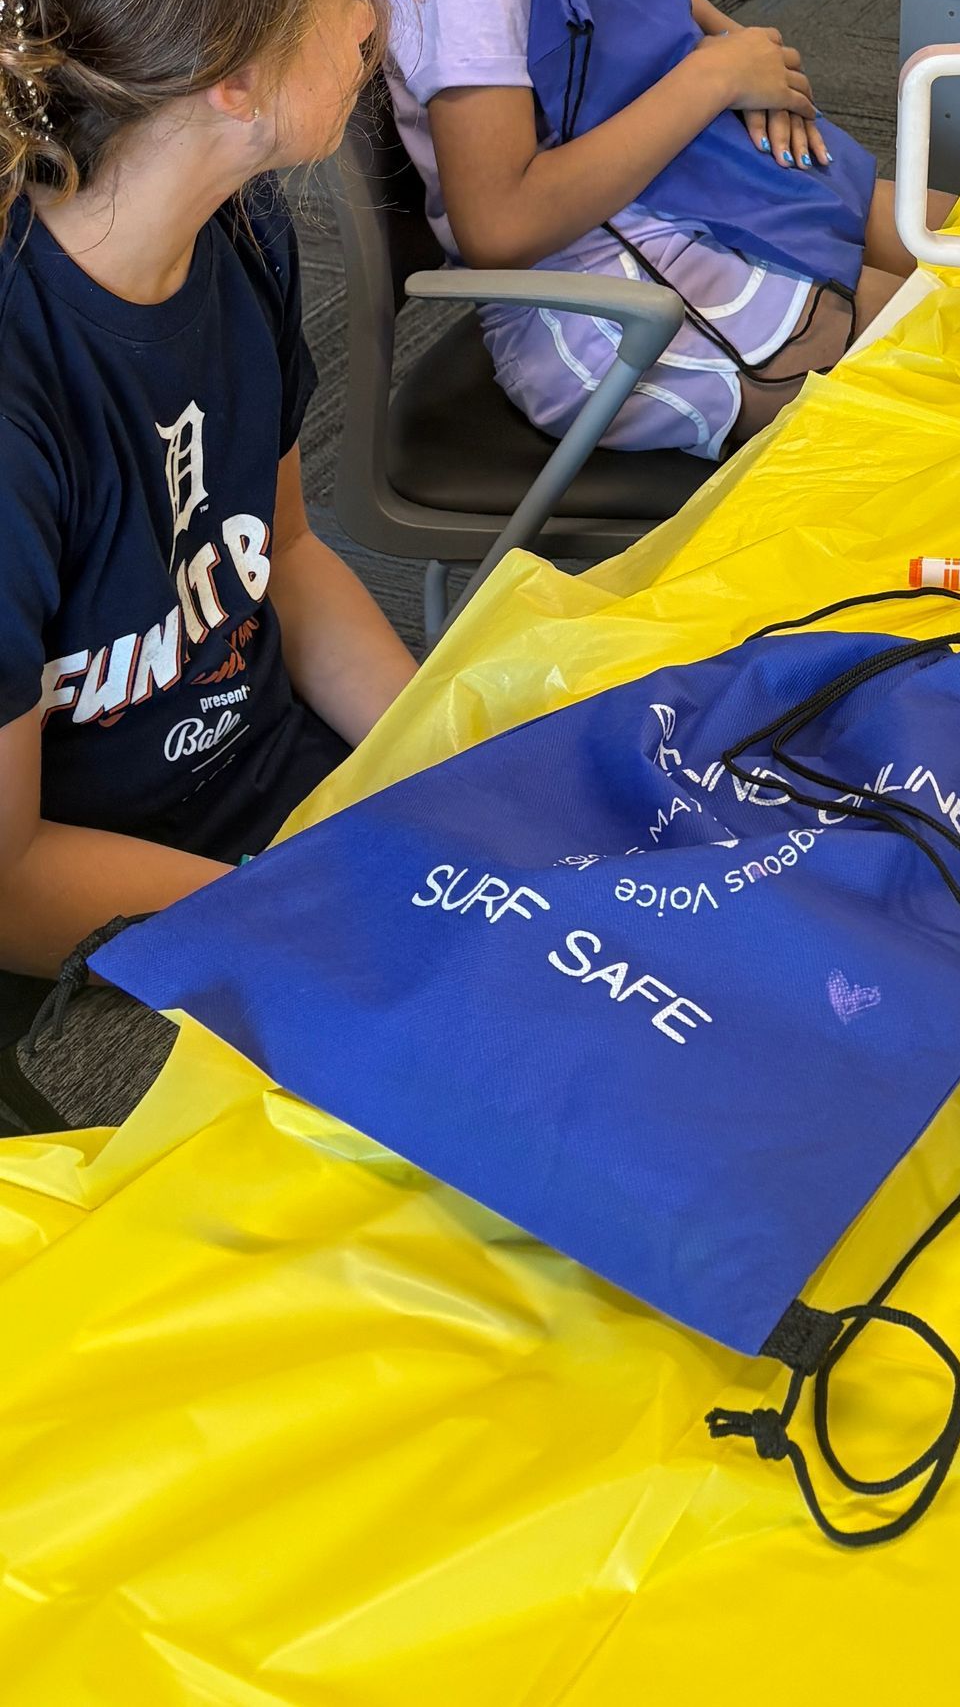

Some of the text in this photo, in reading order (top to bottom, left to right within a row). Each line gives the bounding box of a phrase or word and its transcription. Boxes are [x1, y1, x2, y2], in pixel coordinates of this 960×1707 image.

[154, 399, 209, 575] D
[41, 604, 182, 724] FUN
[411, 863, 551, 925] SURF
[614, 877, 719, 919] Voice
[546, 928, 713, 1046] SAFE
